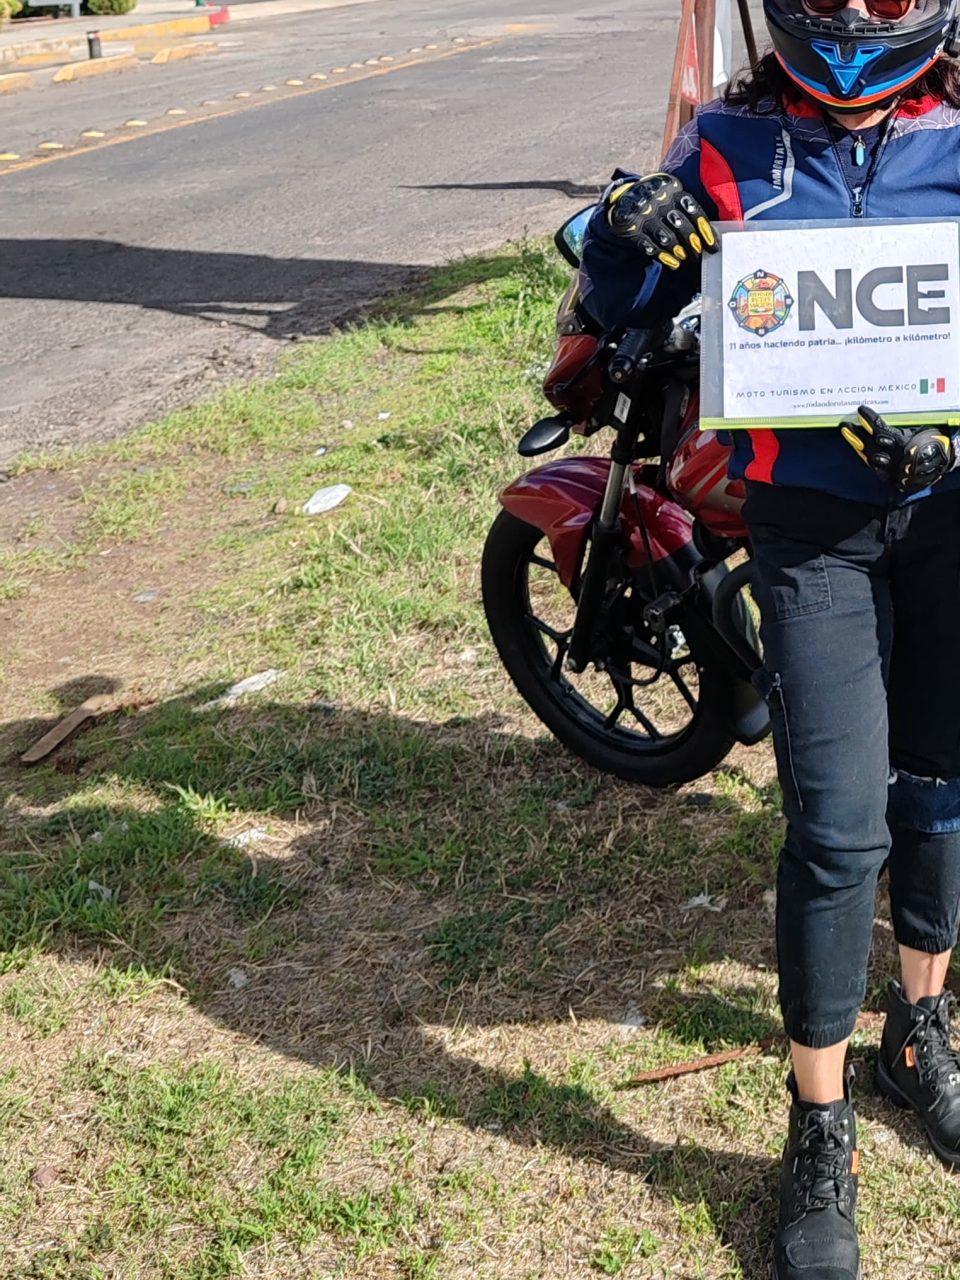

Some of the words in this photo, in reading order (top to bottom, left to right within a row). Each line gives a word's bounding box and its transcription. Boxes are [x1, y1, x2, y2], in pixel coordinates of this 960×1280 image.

[739, 341, 762, 350] años
[763, 339, 806, 349] haciendo
[903, 332, 951, 342] kilómetro!
[736, 390, 766, 398] MOTO
[770, 388, 816, 396] TURISMO
[820, 387, 833, 395] EN
[878, 383, 917, 392] MEXICO
